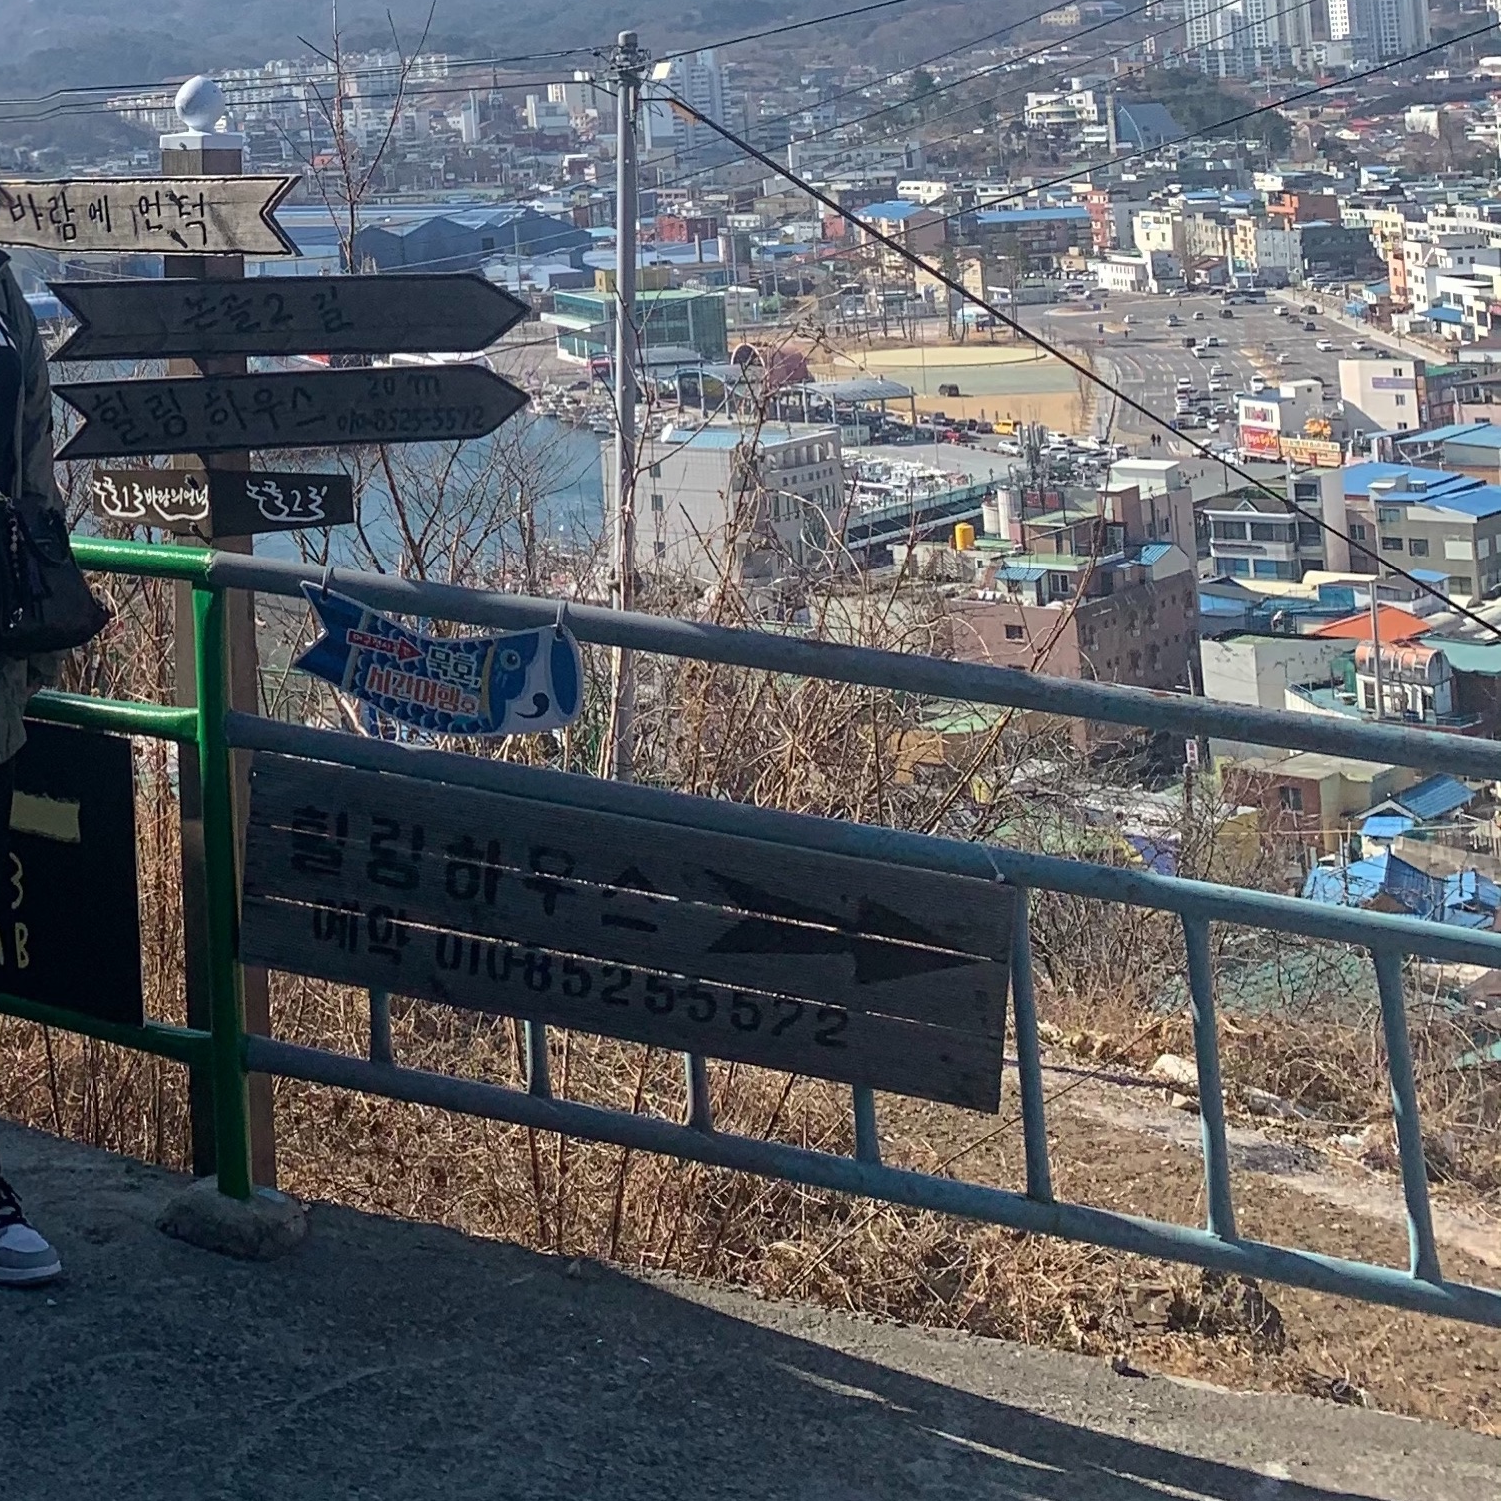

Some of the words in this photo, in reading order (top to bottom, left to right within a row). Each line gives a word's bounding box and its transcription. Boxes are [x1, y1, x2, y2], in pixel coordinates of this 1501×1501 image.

[10, 190, 112, 242] 바람에
[138, 189, 208, 246] 언덕
[92, 386, 326, 445] 힐링하우스
[290, 804, 659, 933] 힐링하우스
[312, 897, 411, 965] 예약
